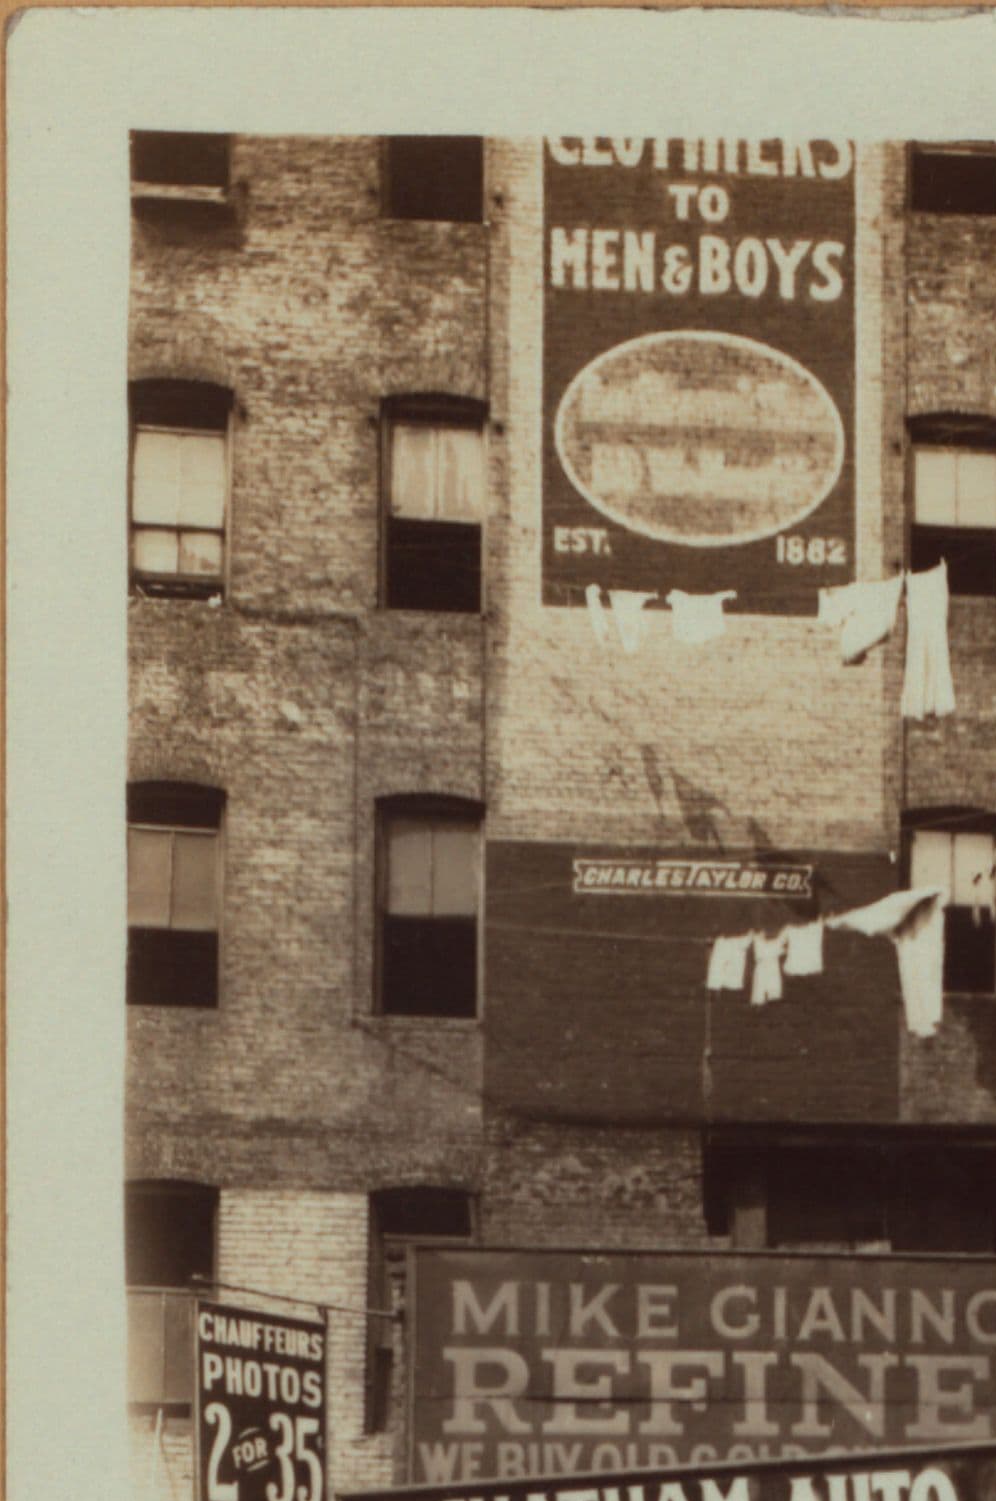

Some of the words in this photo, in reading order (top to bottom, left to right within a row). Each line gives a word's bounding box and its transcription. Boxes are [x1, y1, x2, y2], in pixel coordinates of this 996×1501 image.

[668, 184, 731, 222] TO
[776, 537, 847, 566] 1882
[583, 866, 684, 888] CHARLES
[672, 862, 767, 890] TAYLOR
[452, 1280, 680, 1339] MIKE
[198, 1311, 323, 1362] CHAUFFEURS
[203, 1351, 323, 1409] PHOTOS
[232, 1435, 269, 1471] FOR
[417, 1442, 485, 1483] WE
[497, 1441, 584, 1479] BUY
